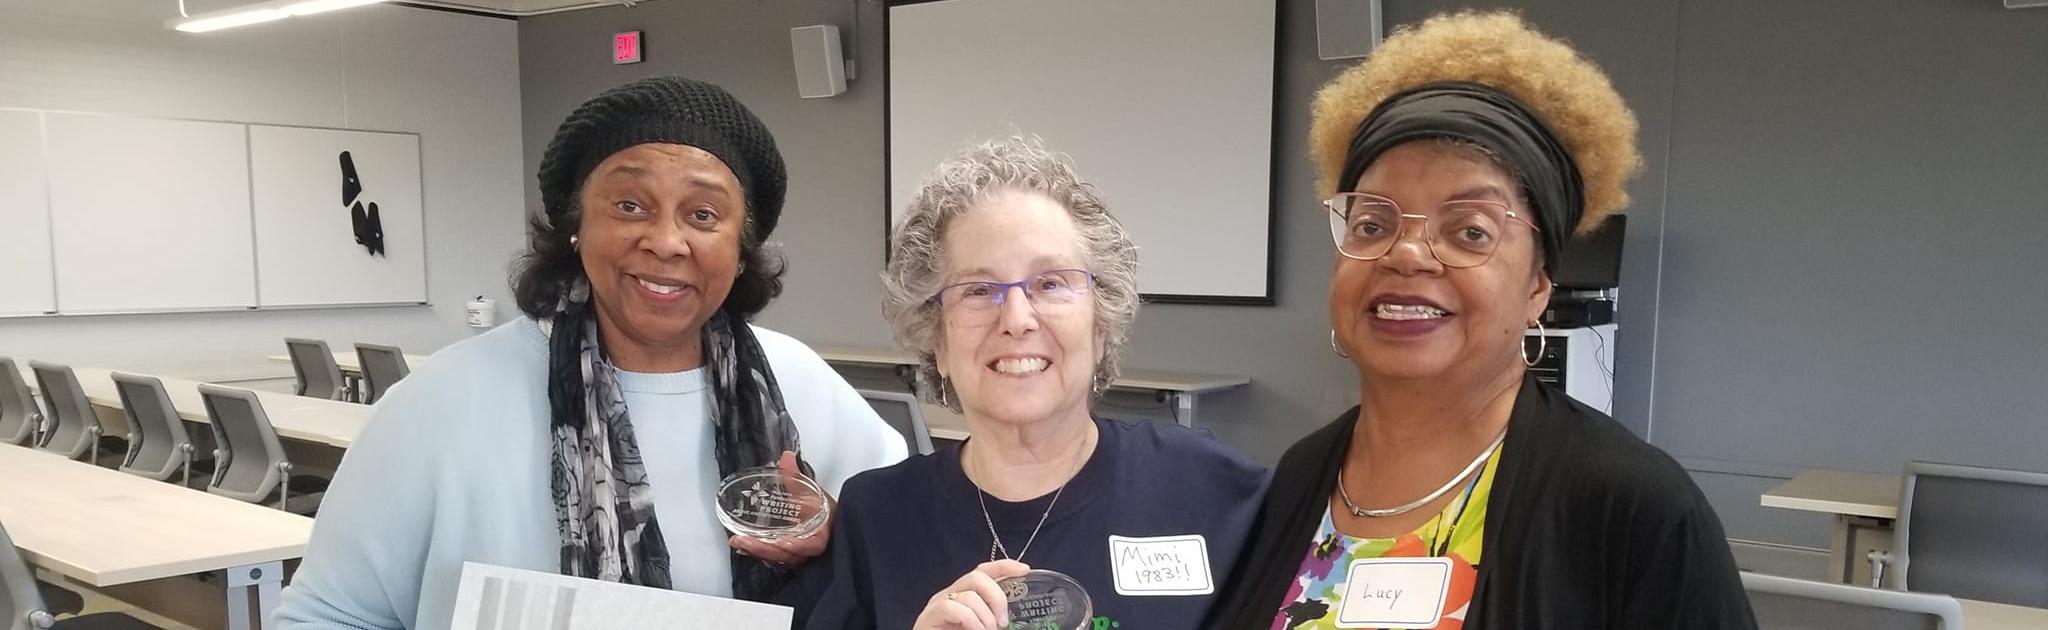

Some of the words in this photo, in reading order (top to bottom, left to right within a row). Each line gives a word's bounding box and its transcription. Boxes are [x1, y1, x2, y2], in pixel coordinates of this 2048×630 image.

[760, 506, 801, 517] PROJECT
[761, 498, 801, 510] WRITING
[1121, 546, 1181, 567] Mimi
[1135, 563, 1191, 584] 1983!!
[1362, 583, 1403, 610] Lucy
